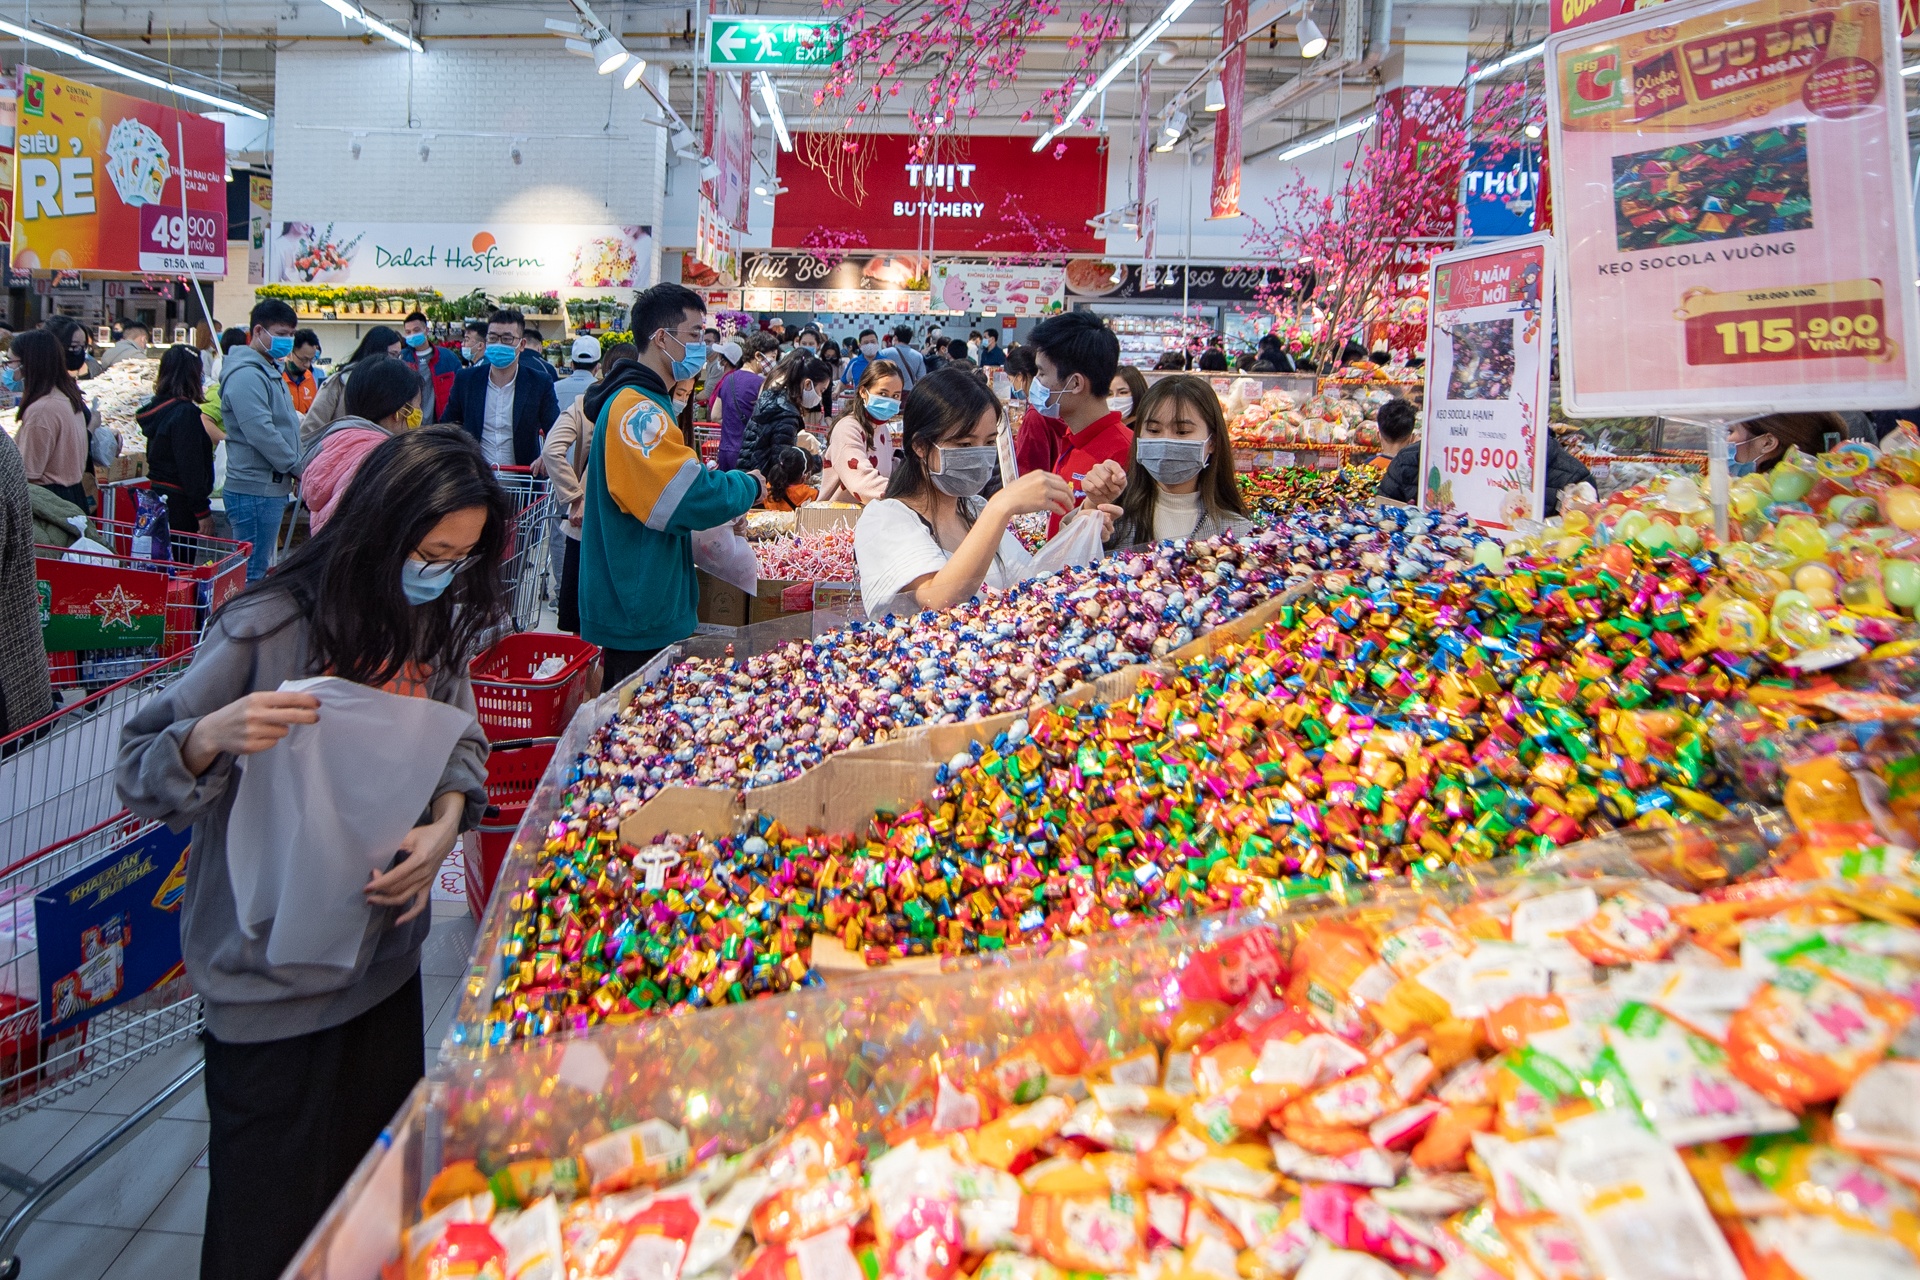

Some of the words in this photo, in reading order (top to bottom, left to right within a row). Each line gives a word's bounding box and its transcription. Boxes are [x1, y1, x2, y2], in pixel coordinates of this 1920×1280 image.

[796, 46, 828, 60] EXIT
[1573, 60, 1599, 74] Big
[1576, 54, 1618, 102] C
[19, 130, 58, 154] SIÊU
[20, 137, 96, 220] RẺ
[185, 180, 197, 190] ZAI
[197, 183, 208, 192] ZAI
[193, 169, 207, 181] RAU
[904, 164, 976, 192] THỊT
[893, 201, 984, 218] BUTCHERY
[376, 245, 437, 268] Dalat
[444, 246, 545, 273] Hasfarm
[1598, 261, 1633, 276] KẸO
[1640, 251, 1716, 271] SOCOLA
[1722, 242, 1796, 261] VUÔNG
[1481, 264, 1511, 284] NĂM
[1482, 284, 1506, 304] MỚI
[1443, 446, 1519, 475] 159.900
